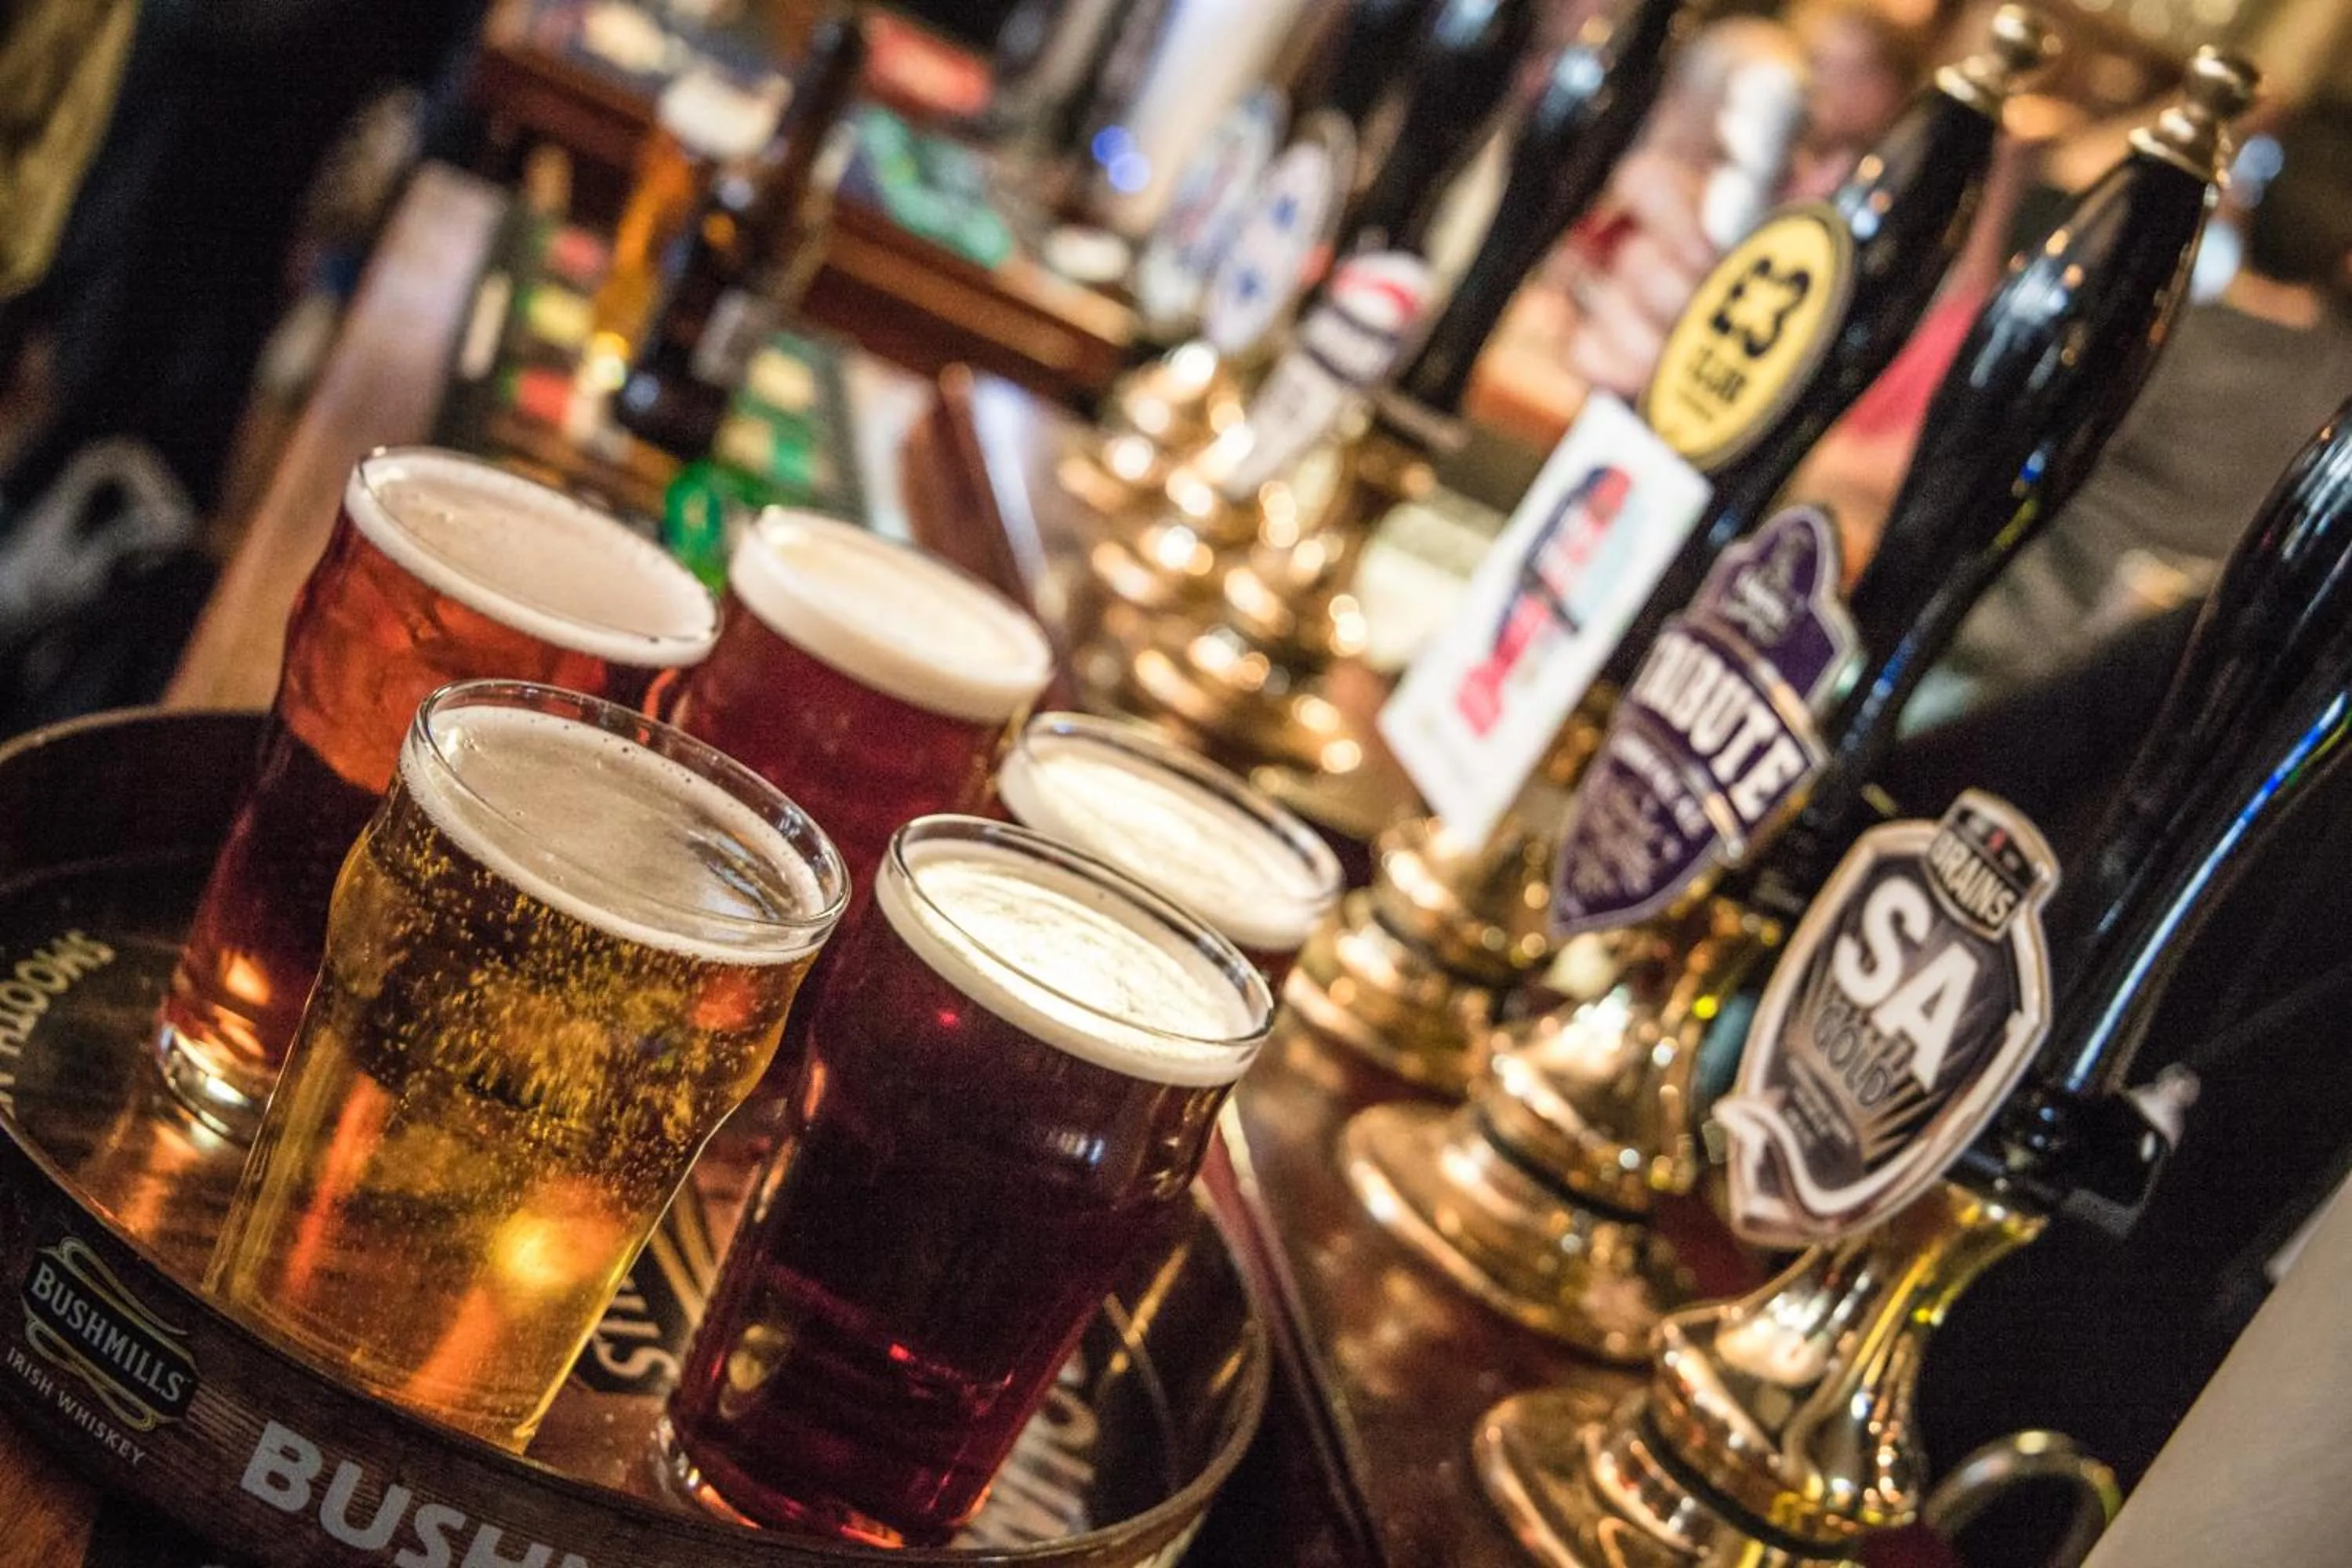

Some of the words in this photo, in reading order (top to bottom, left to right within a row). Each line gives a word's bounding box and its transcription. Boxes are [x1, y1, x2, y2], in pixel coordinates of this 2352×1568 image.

[1930, 831, 2016, 925] BRAINS
[1833, 876, 1978, 1091] SA
[31, 1261, 185, 1403] BUSHMILLS
[6, 1347, 54, 1396] IRISH
[57, 1391, 147, 1457] WHISKEY
